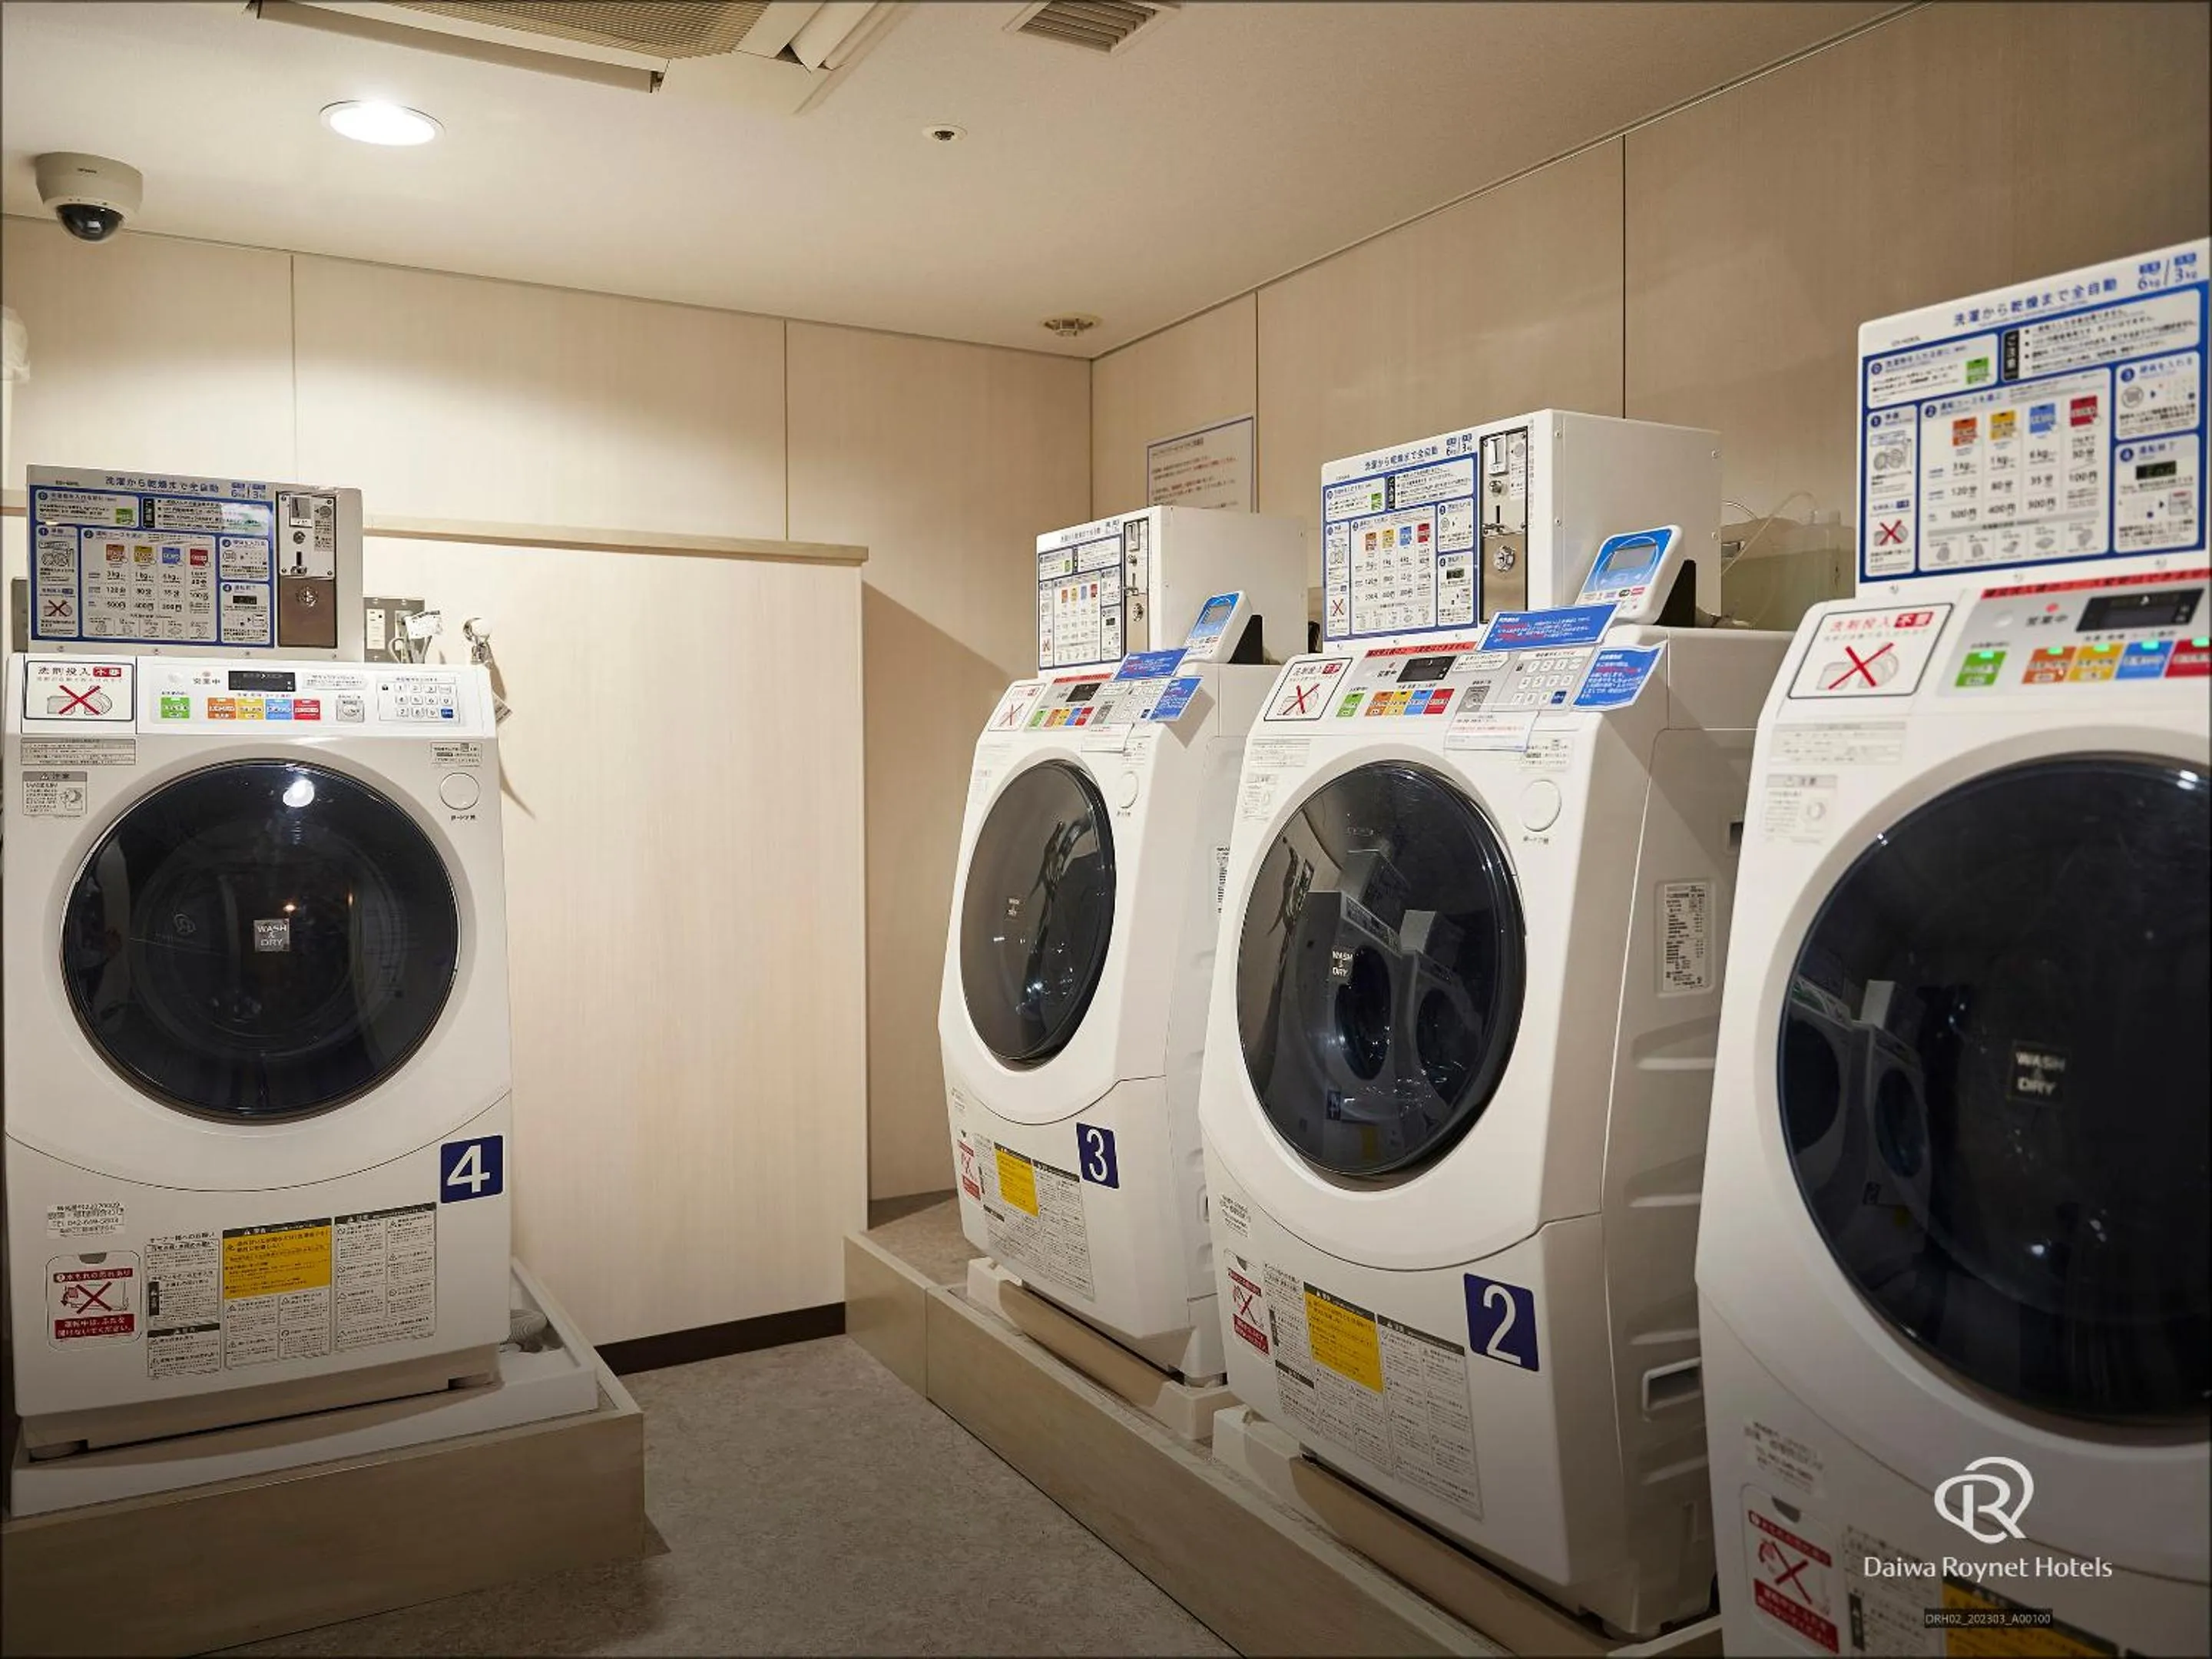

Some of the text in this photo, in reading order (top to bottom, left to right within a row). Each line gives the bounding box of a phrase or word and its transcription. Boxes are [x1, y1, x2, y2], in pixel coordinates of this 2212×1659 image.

[1954, 278, 2117, 326] 洗濯から乾燥まで全自動
[105, 475, 220, 494] 洗濯から乾燥まで全自動
[38, 667, 91, 677] 洗剤投入
[2015, 1051, 2065, 1072] WASH
[2018, 1077, 2056, 1096] DRY
[445, 1145, 492, 1194] 4
[1086, 1129, 1108, 1182] 3
[1483, 1284, 1522, 1366] 2
